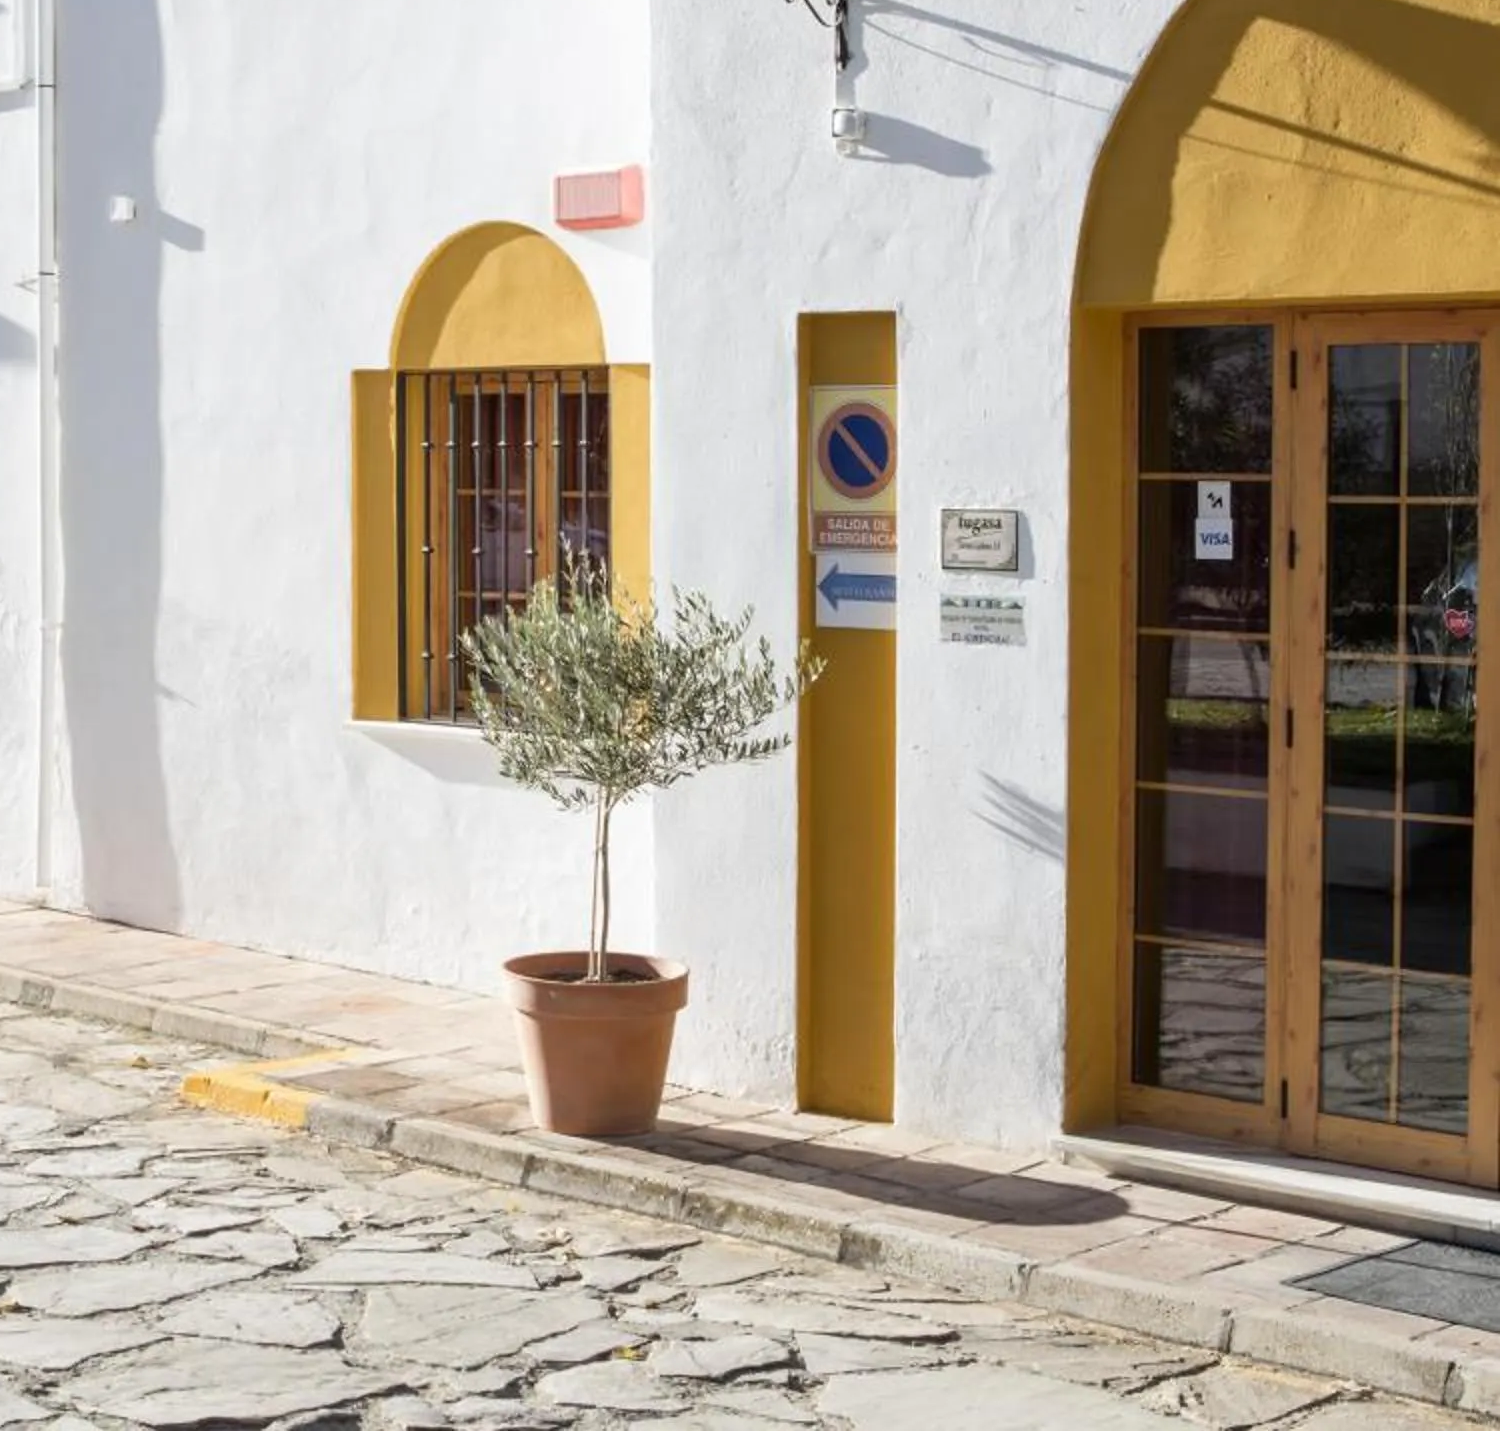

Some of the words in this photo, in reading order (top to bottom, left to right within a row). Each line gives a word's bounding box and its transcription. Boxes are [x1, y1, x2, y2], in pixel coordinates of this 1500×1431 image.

[826, 518, 870, 531] SALIDA
[873, 519, 892, 532] DE
[958, 515, 1002, 537] tugasa
[1199, 532, 1231, 546] VISA
